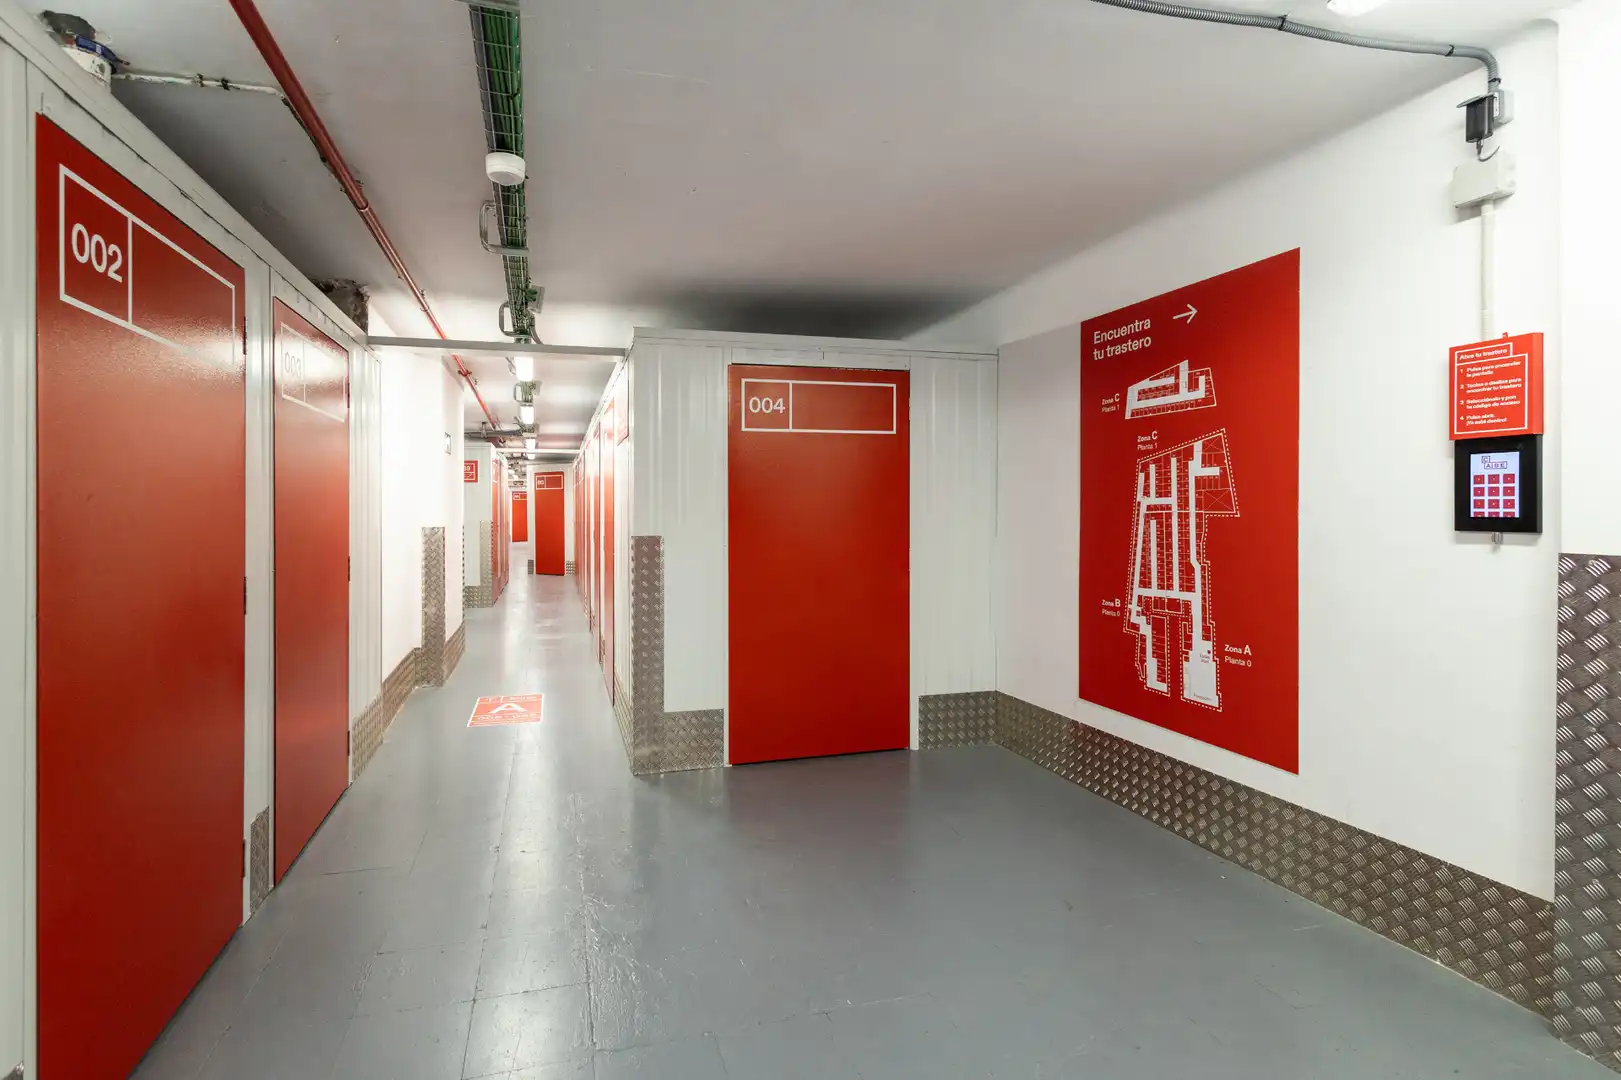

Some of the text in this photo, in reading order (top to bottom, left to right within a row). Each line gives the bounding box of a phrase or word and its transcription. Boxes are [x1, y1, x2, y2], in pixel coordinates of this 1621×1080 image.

[71, 223, 122, 283] 002
[1093, 318, 1151, 345] Encuentra
[1093, 336, 1152, 361] tu trastero
[1482, 348, 1508, 356] trastero
[1114, 393, 1120, 402] C
[749, 397, 786, 413] 004
[1137, 430, 1158, 443] Zona C
[1101, 598, 1121, 607] Zona B
[1224, 644, 1252, 656] Zona A
[1224, 656, 1252, 667] Planta 0
